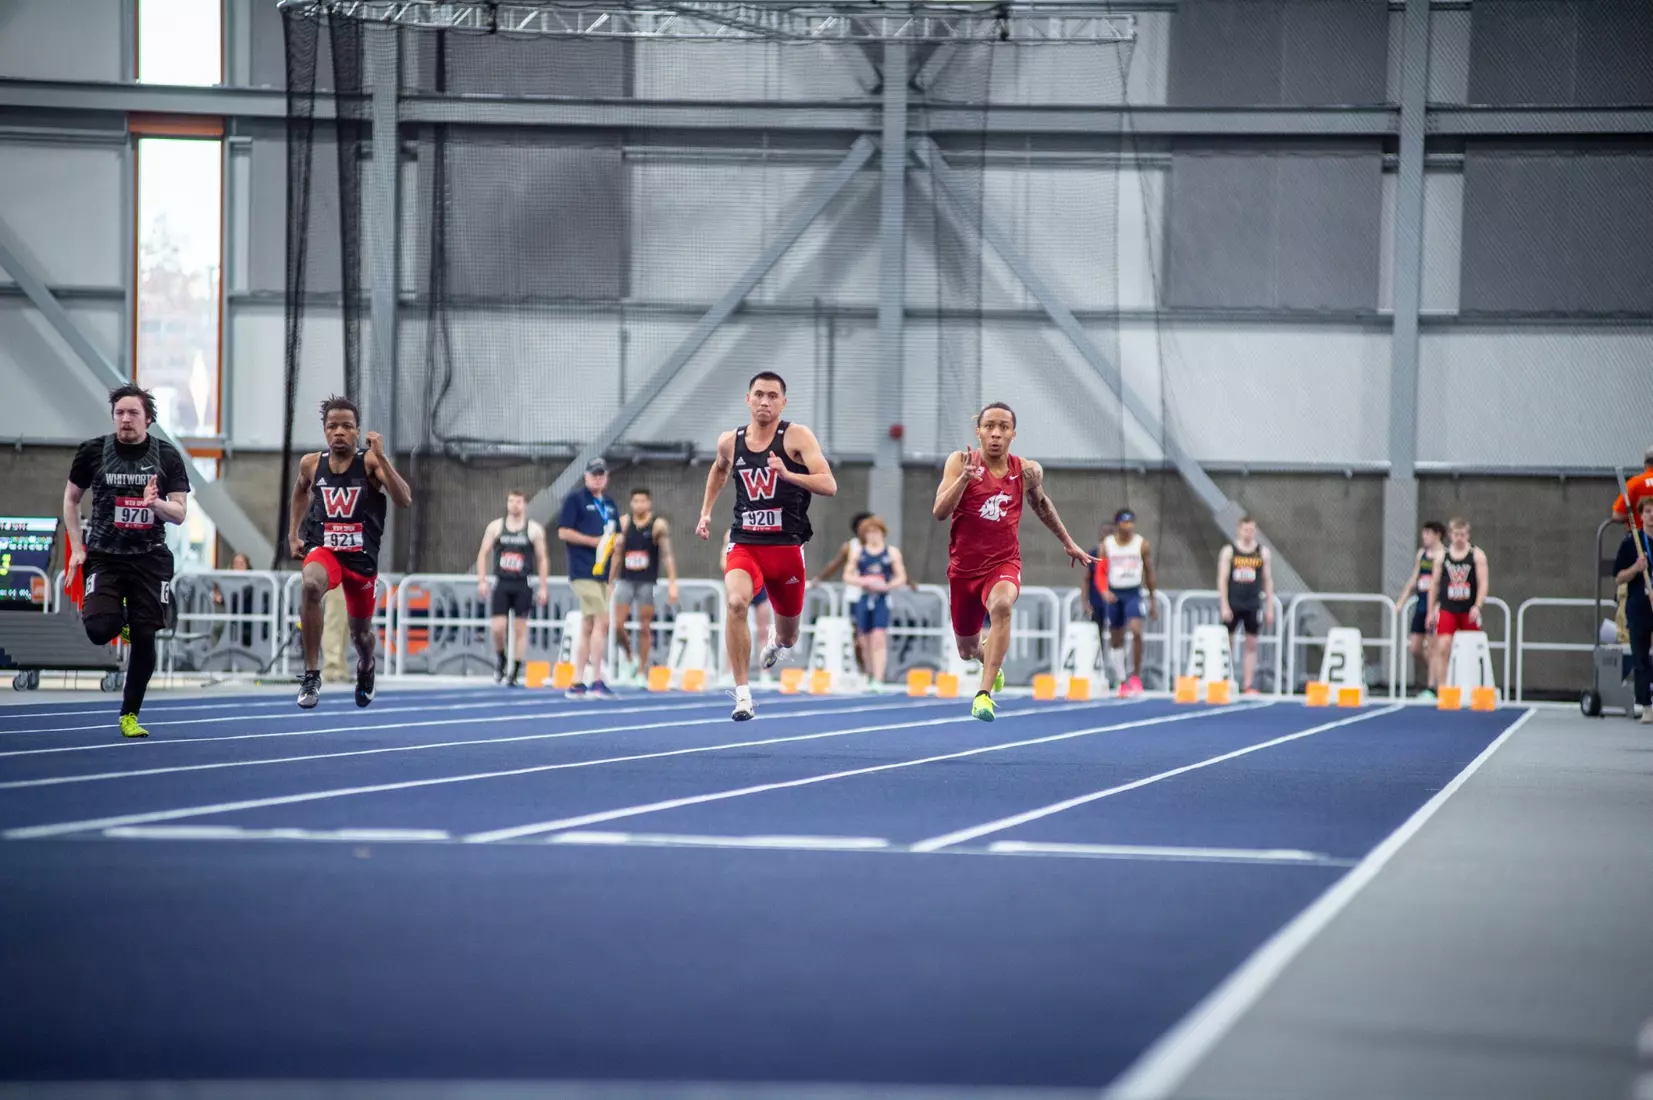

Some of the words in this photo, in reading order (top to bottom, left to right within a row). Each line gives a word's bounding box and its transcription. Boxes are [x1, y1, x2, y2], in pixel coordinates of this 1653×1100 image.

[105, 473, 156, 486] WHITWORT
[739, 466, 778, 501] W
[320, 486, 361, 518] W
[121, 508, 149, 524] 970
[748, 510, 775, 526] 920
[330, 533, 356, 547] 921
[1328, 652, 1345, 683] 2
